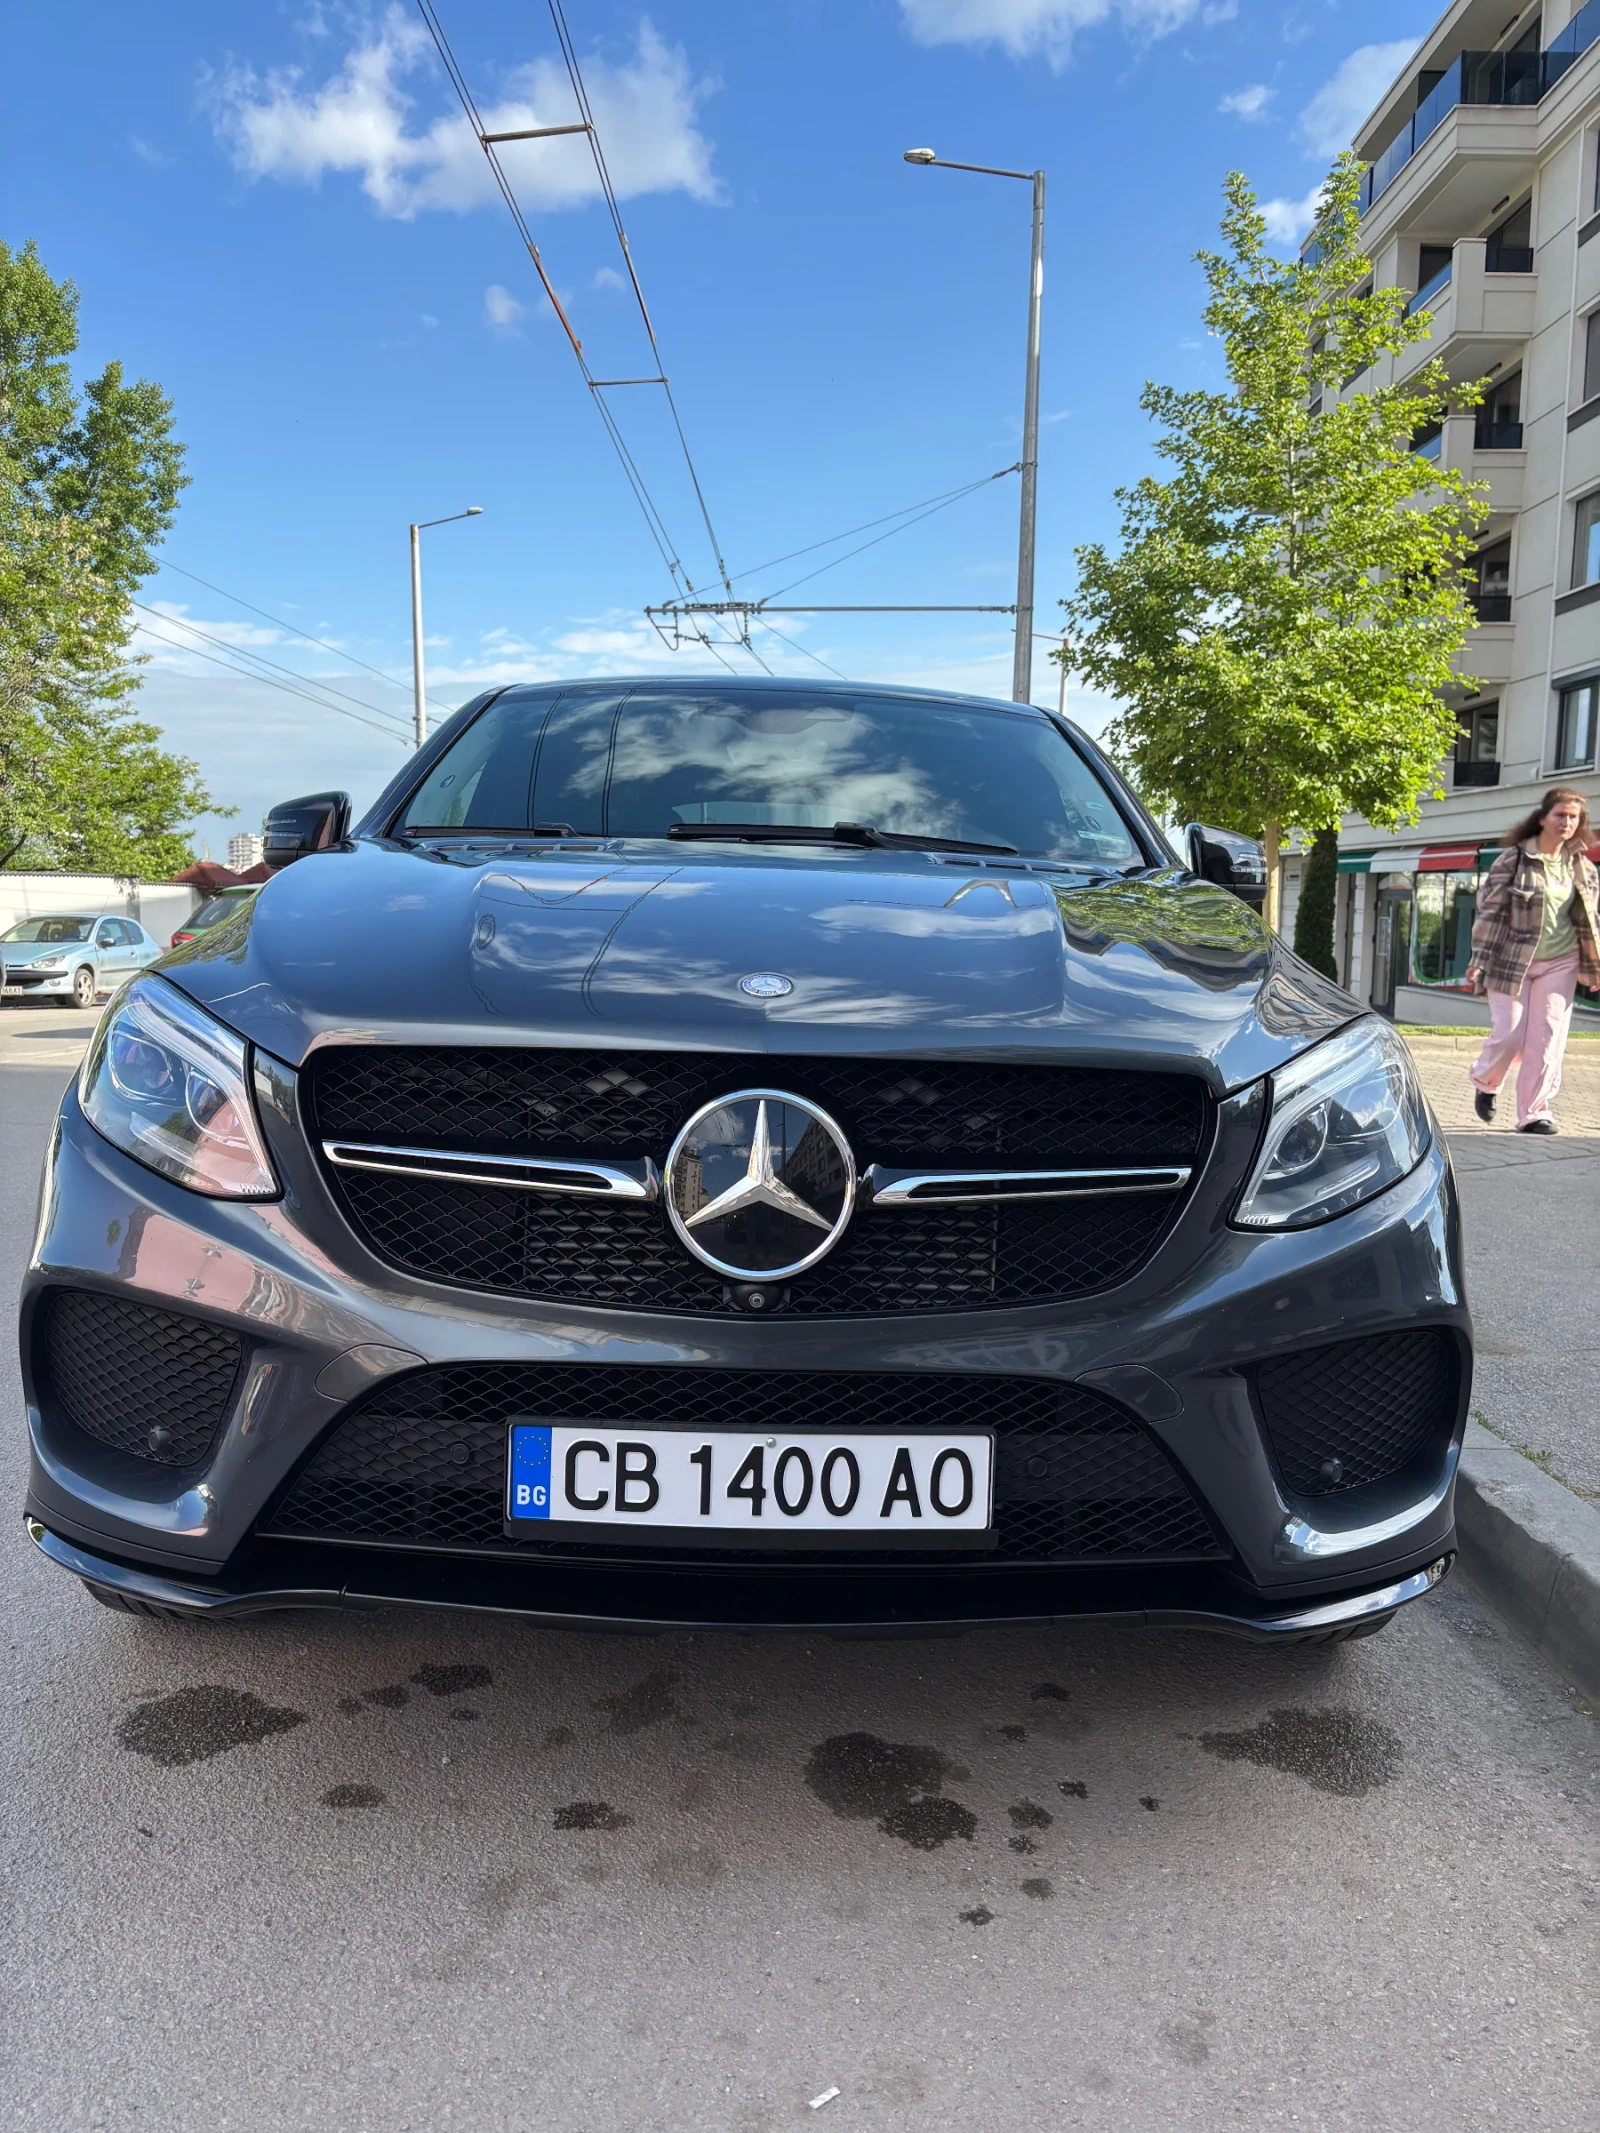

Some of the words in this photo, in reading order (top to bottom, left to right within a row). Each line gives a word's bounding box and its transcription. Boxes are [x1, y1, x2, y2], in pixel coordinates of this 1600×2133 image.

[516, 1484, 547, 1506] BG
[565, 1440, 660, 1512] CB
[690, 1444, 861, 1517] 1400
[879, 1447, 974, 1518] AO
